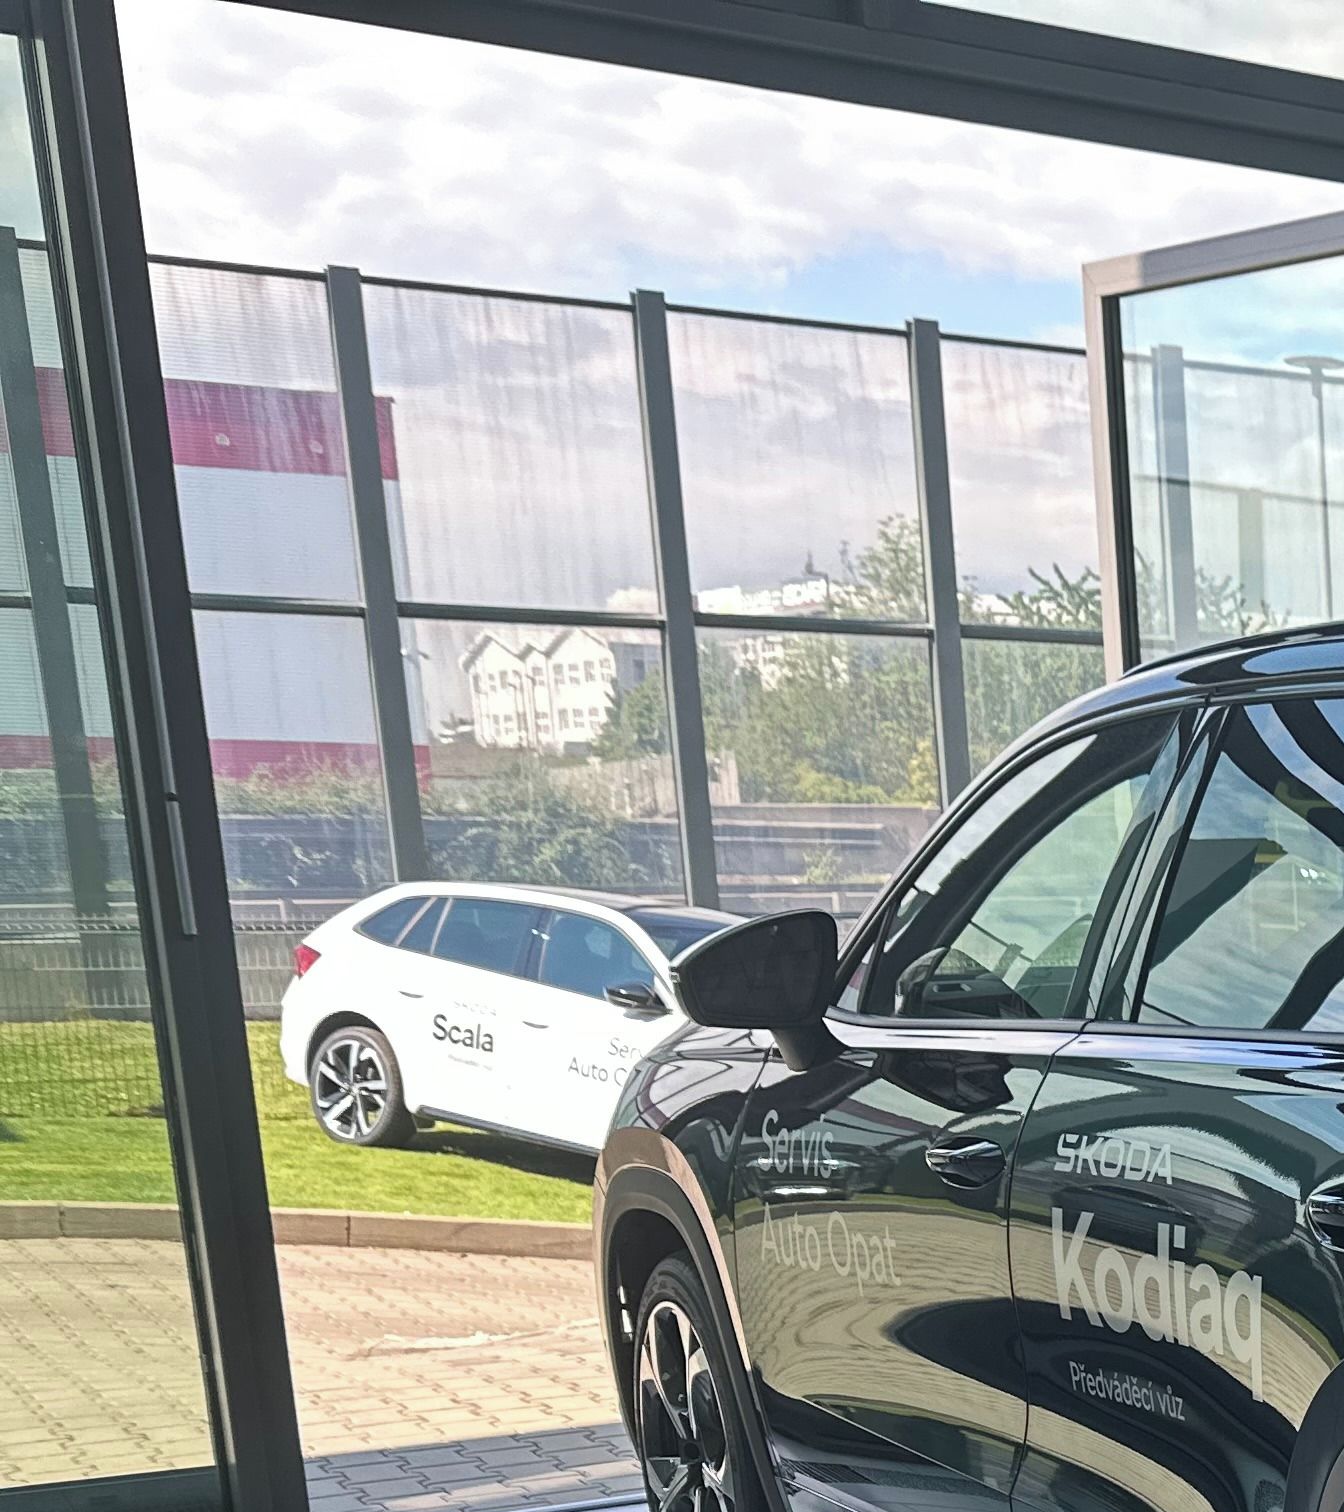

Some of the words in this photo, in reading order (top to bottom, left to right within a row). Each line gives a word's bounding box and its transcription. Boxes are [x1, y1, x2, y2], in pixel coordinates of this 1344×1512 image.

[432, 1013, 494, 1053] Scala
[568, 1056, 609, 1082] Auto
[760, 1109, 836, 1178] Servis
[761, 1202, 822, 1272] Auto
[827, 1210, 902, 1296] Opat
[1051, 1206, 1264, 1402] Kodiaq
[1069, 1360, 1155, 1412] Předváděcí
[1154, 1382, 1186, 1421] vůz
